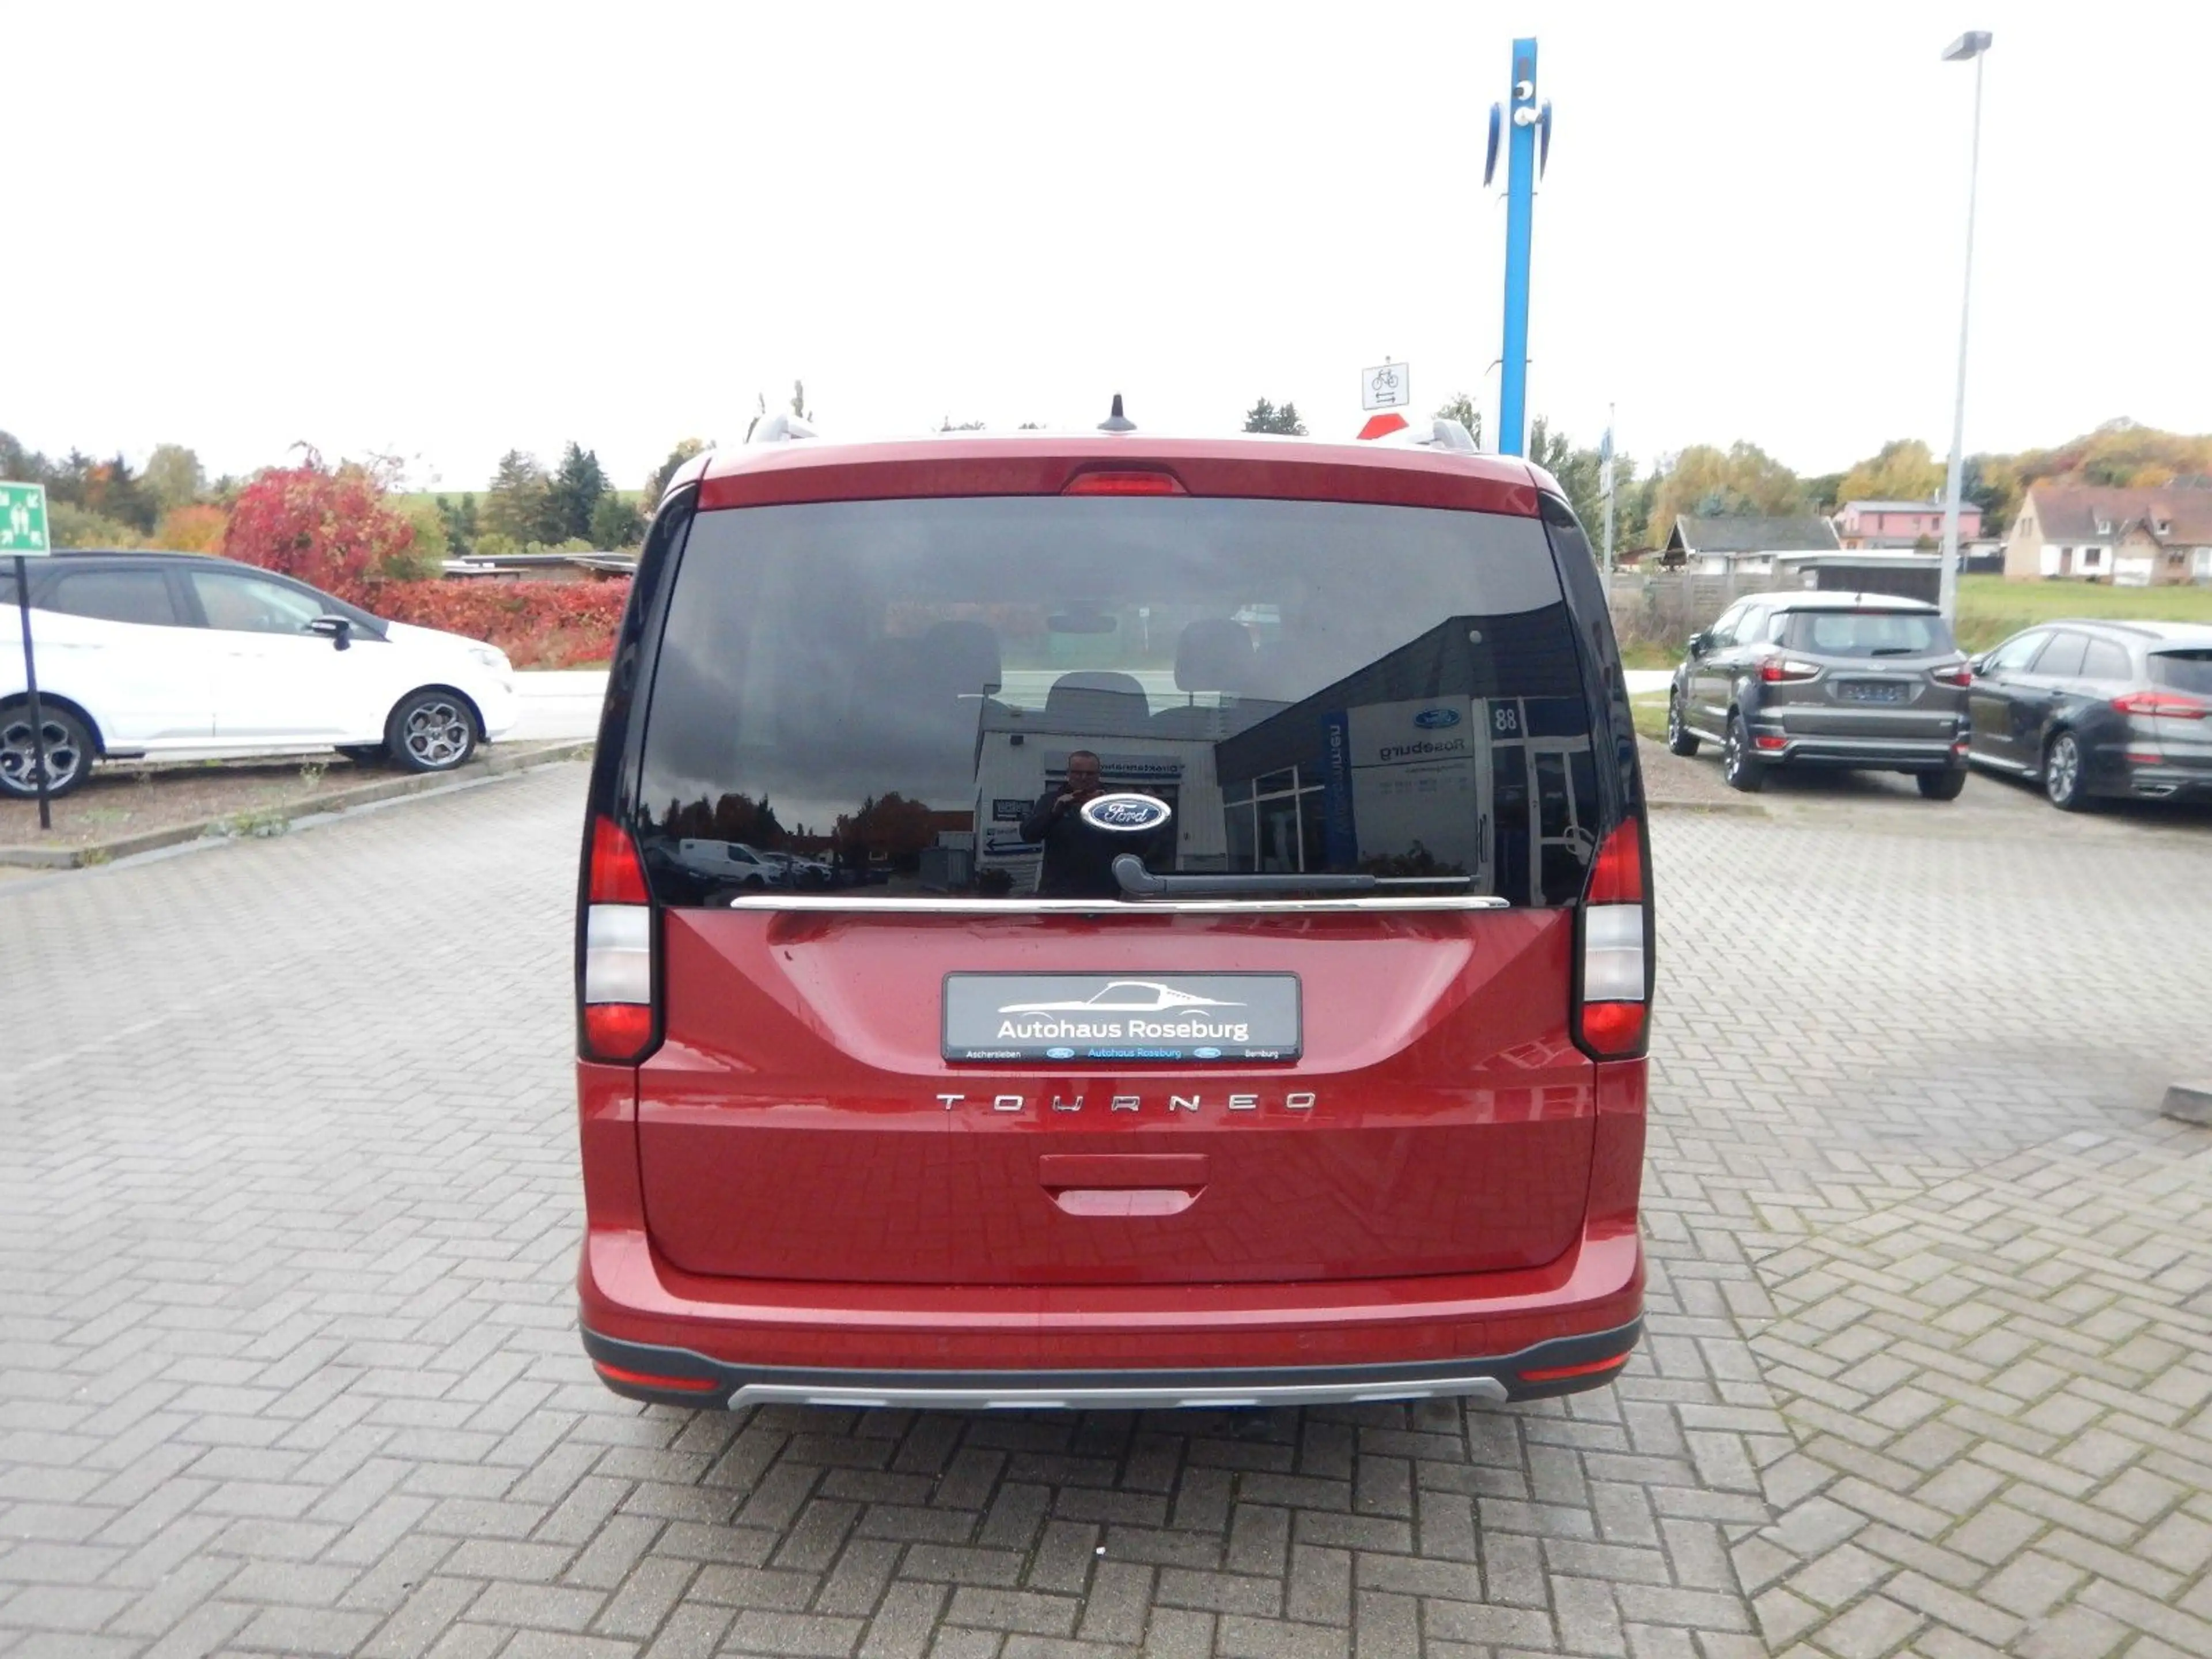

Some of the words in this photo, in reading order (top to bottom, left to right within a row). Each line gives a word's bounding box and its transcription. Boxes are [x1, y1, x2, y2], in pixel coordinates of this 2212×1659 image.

[1104, 804, 1149, 823] Ford
[998, 1020, 1122, 1038] Autohaus
[1128, 1020, 1249, 1041] Roseburg
[966, 1050, 1021, 1059] Aschersleben
[1088, 1048, 1135, 1058] Autohaus
[1138, 1048, 1181, 1059] Roseburg
[1245, 1049, 1279, 1059] Bernburg
[936, 1092, 1317, 1112] TOURNEO
